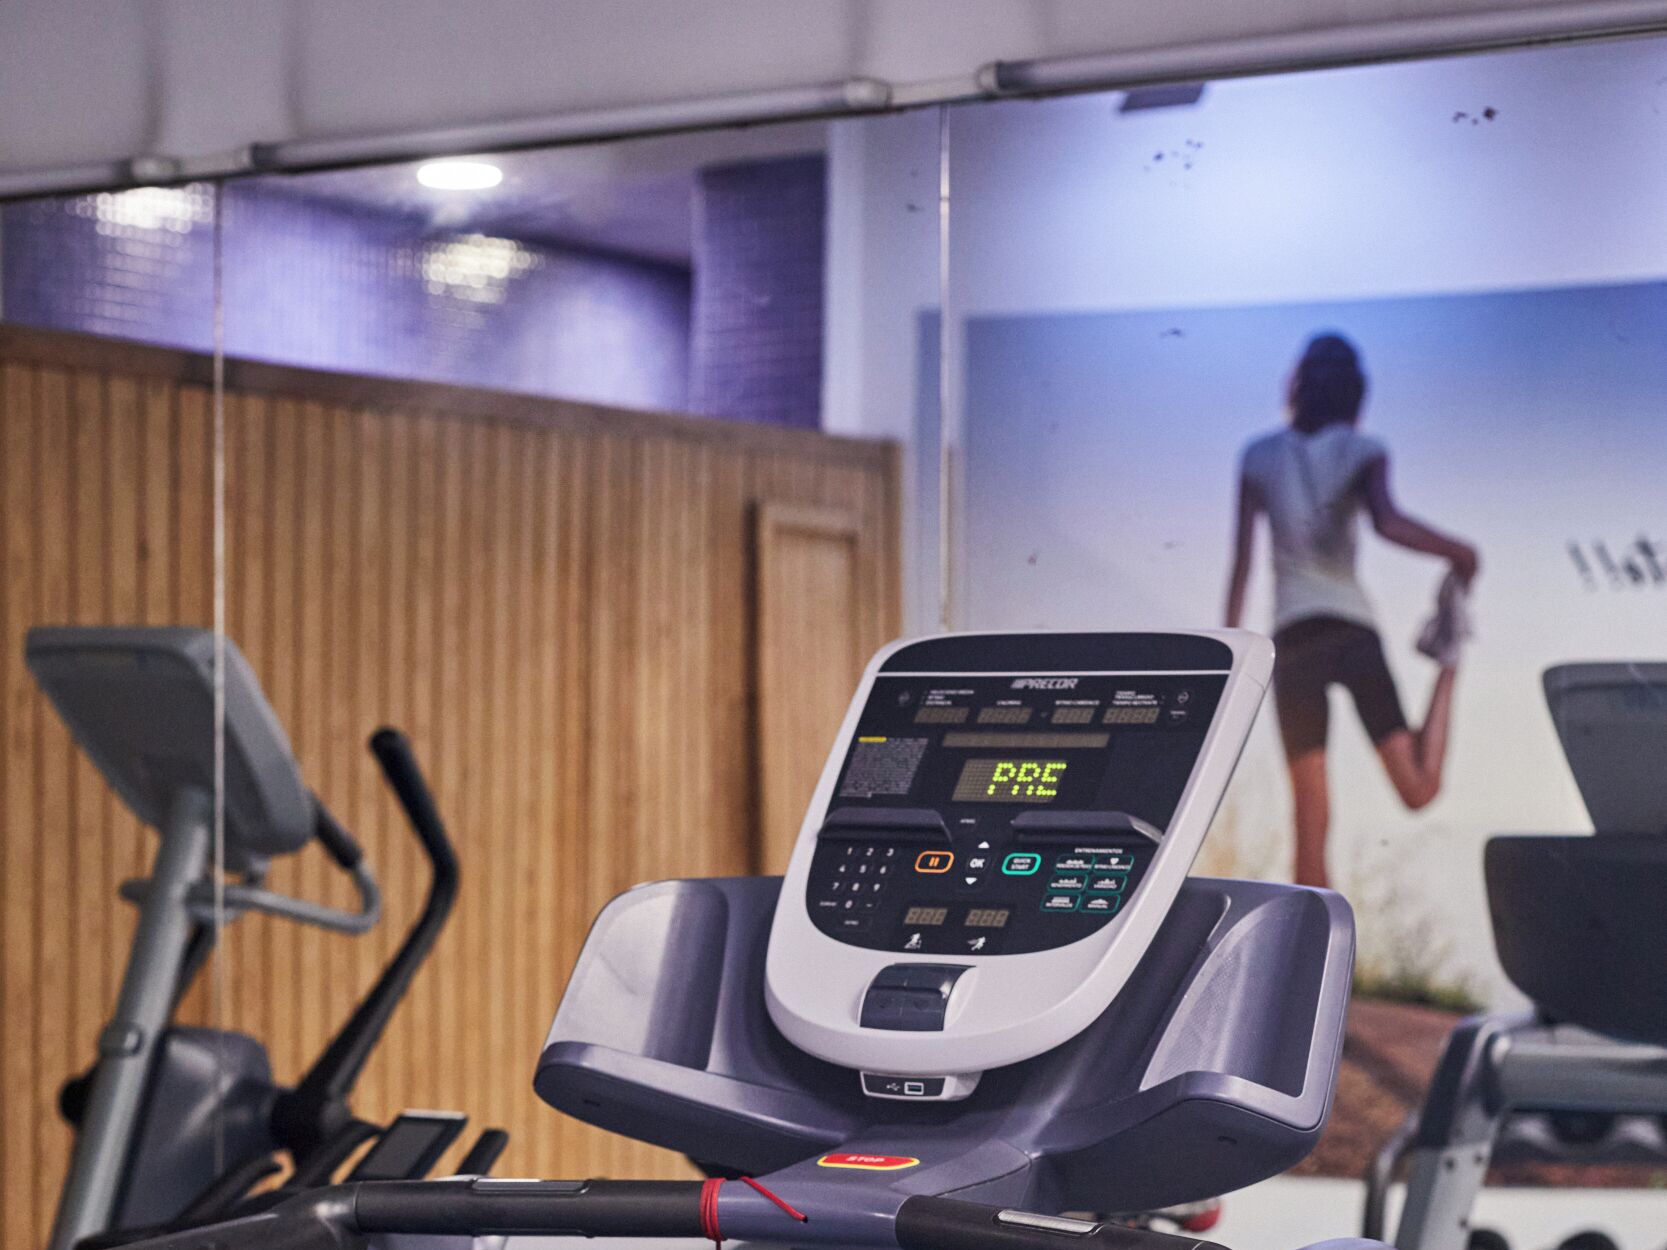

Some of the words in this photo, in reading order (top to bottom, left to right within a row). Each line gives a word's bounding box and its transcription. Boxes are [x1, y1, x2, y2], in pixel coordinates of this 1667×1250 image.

[1020, 678, 1079, 690] PRECOR
[987, 762, 1067, 796] PRE
[866, 847, 874, 857] 2
[886, 848, 894, 857] 3
[969, 858, 985, 869] OK
